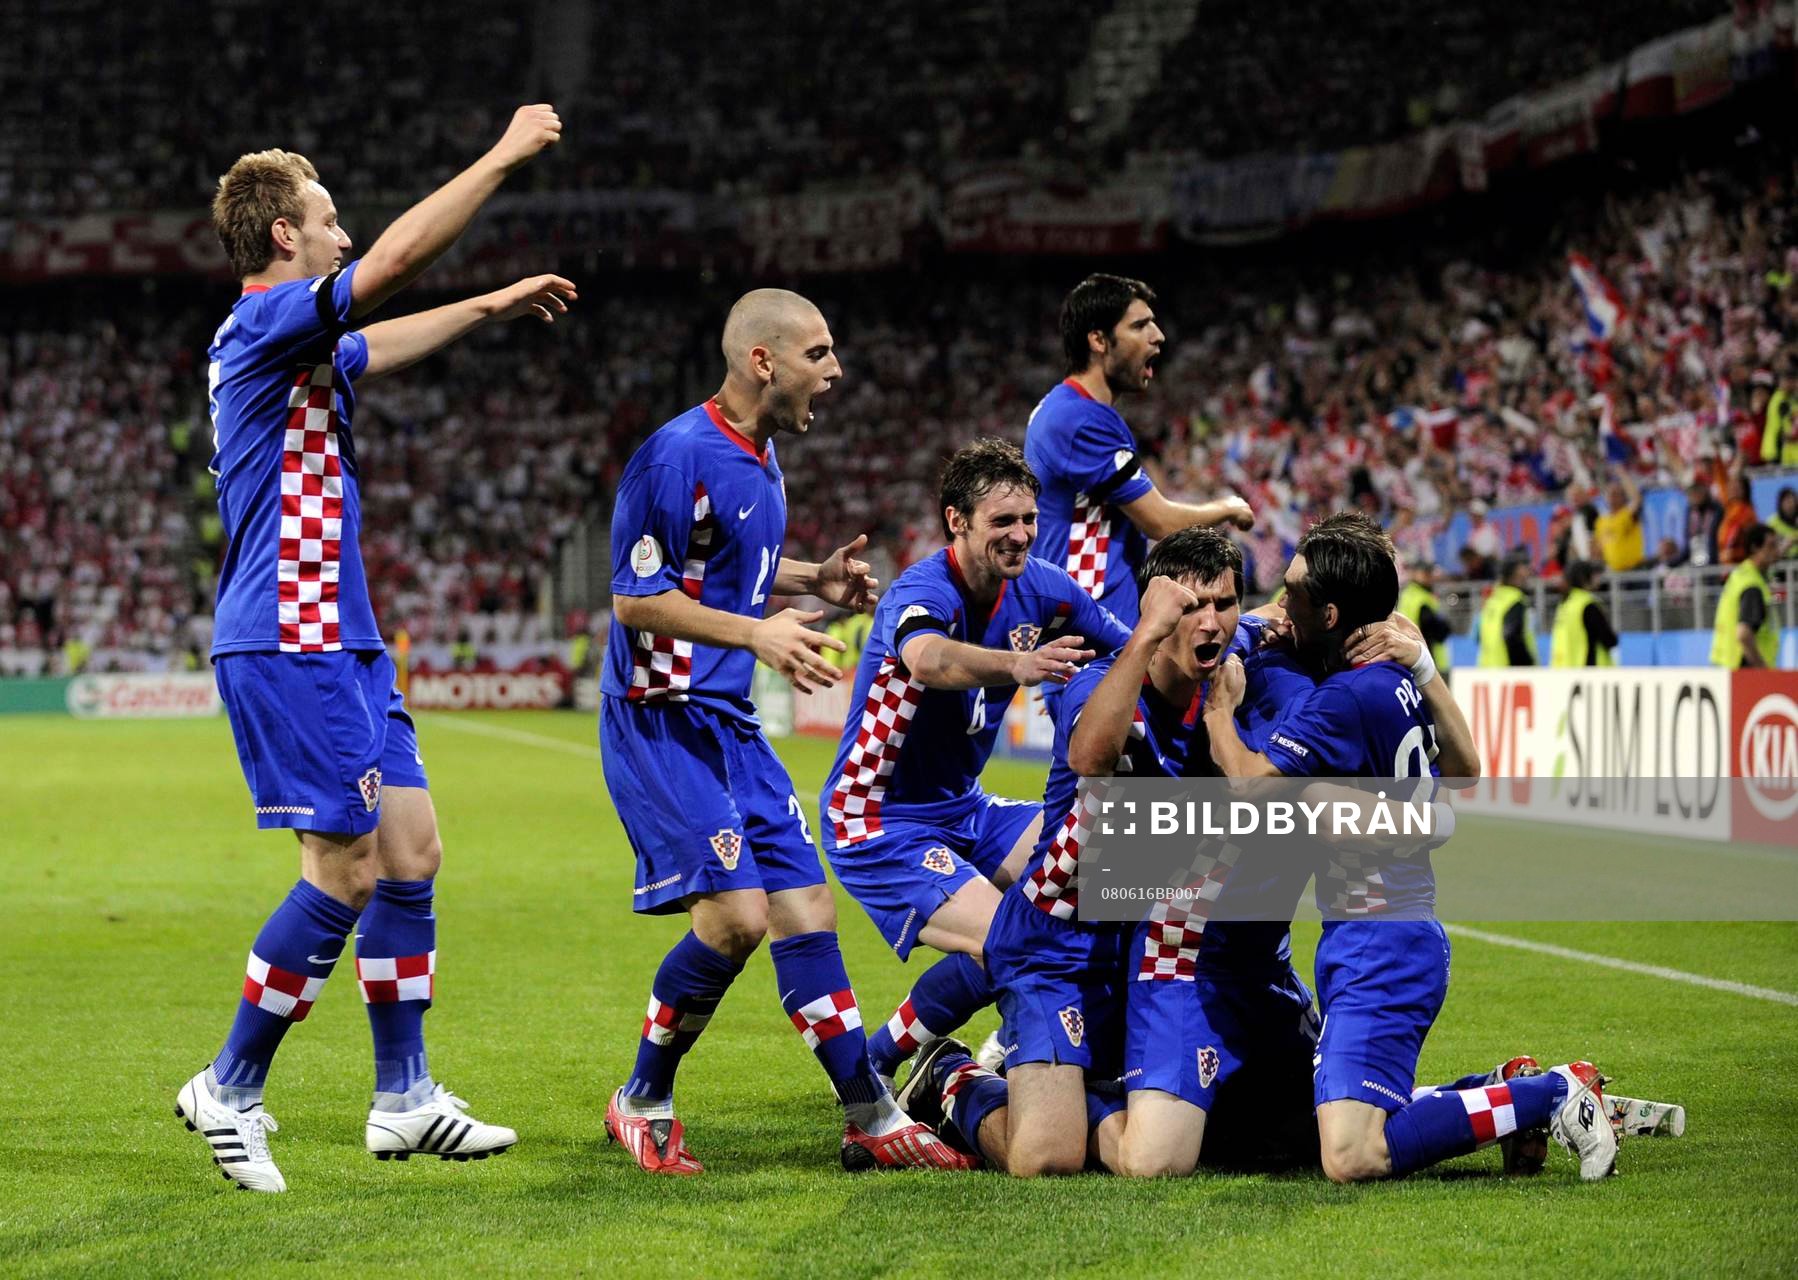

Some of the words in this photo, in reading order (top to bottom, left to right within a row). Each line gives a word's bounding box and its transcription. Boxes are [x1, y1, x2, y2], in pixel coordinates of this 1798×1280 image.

[411, 673, 563, 708] MOTORS
[1277, 736, 1310, 758] RESPECT
[1568, 683, 1641, 814] SLIM
[1655, 684, 1721, 819] LCD
[1753, 725, 1798, 790] KIA
